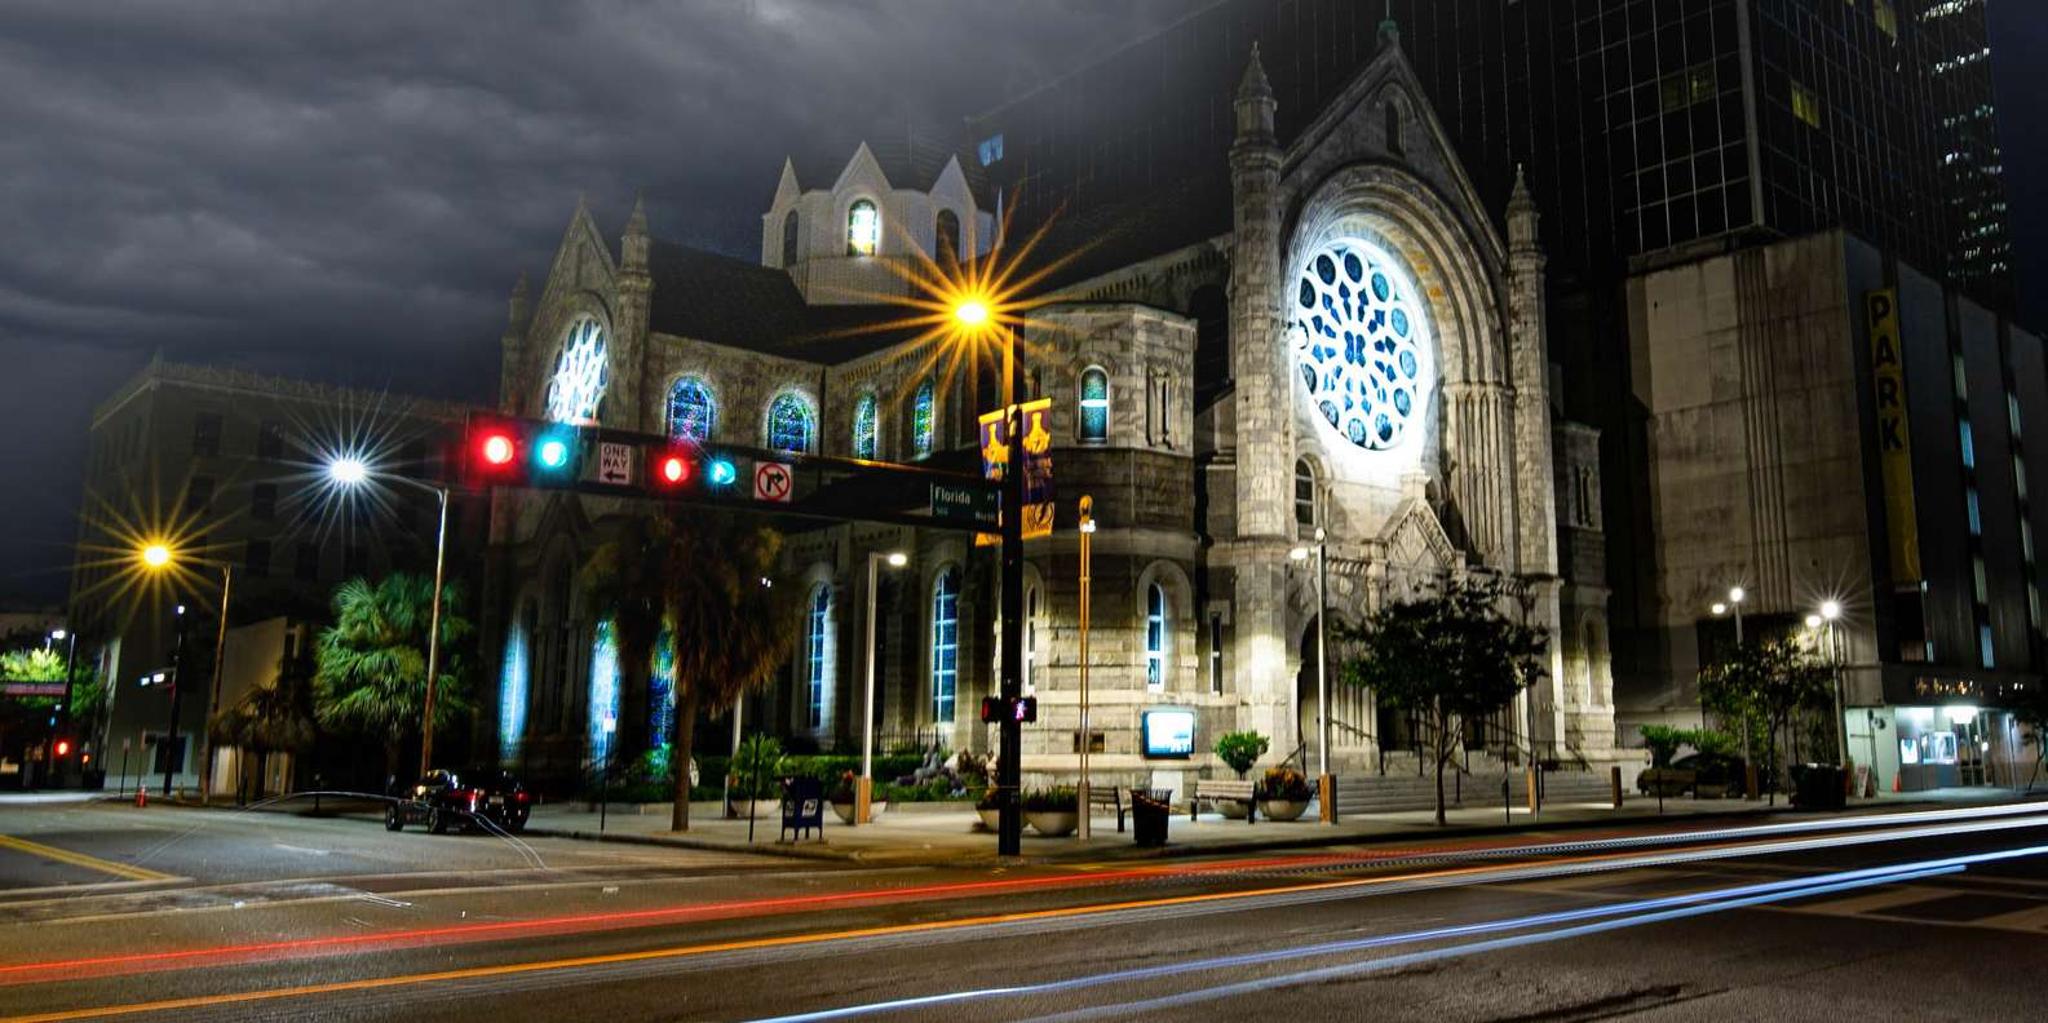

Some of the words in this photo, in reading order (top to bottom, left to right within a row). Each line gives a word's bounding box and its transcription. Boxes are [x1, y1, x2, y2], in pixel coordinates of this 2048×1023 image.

[1870, 295, 1902, 450] PARK
[603, 444, 627, 457] ONE
[603, 457, 627, 469] WAY
[934, 485, 971, 505] Florida
